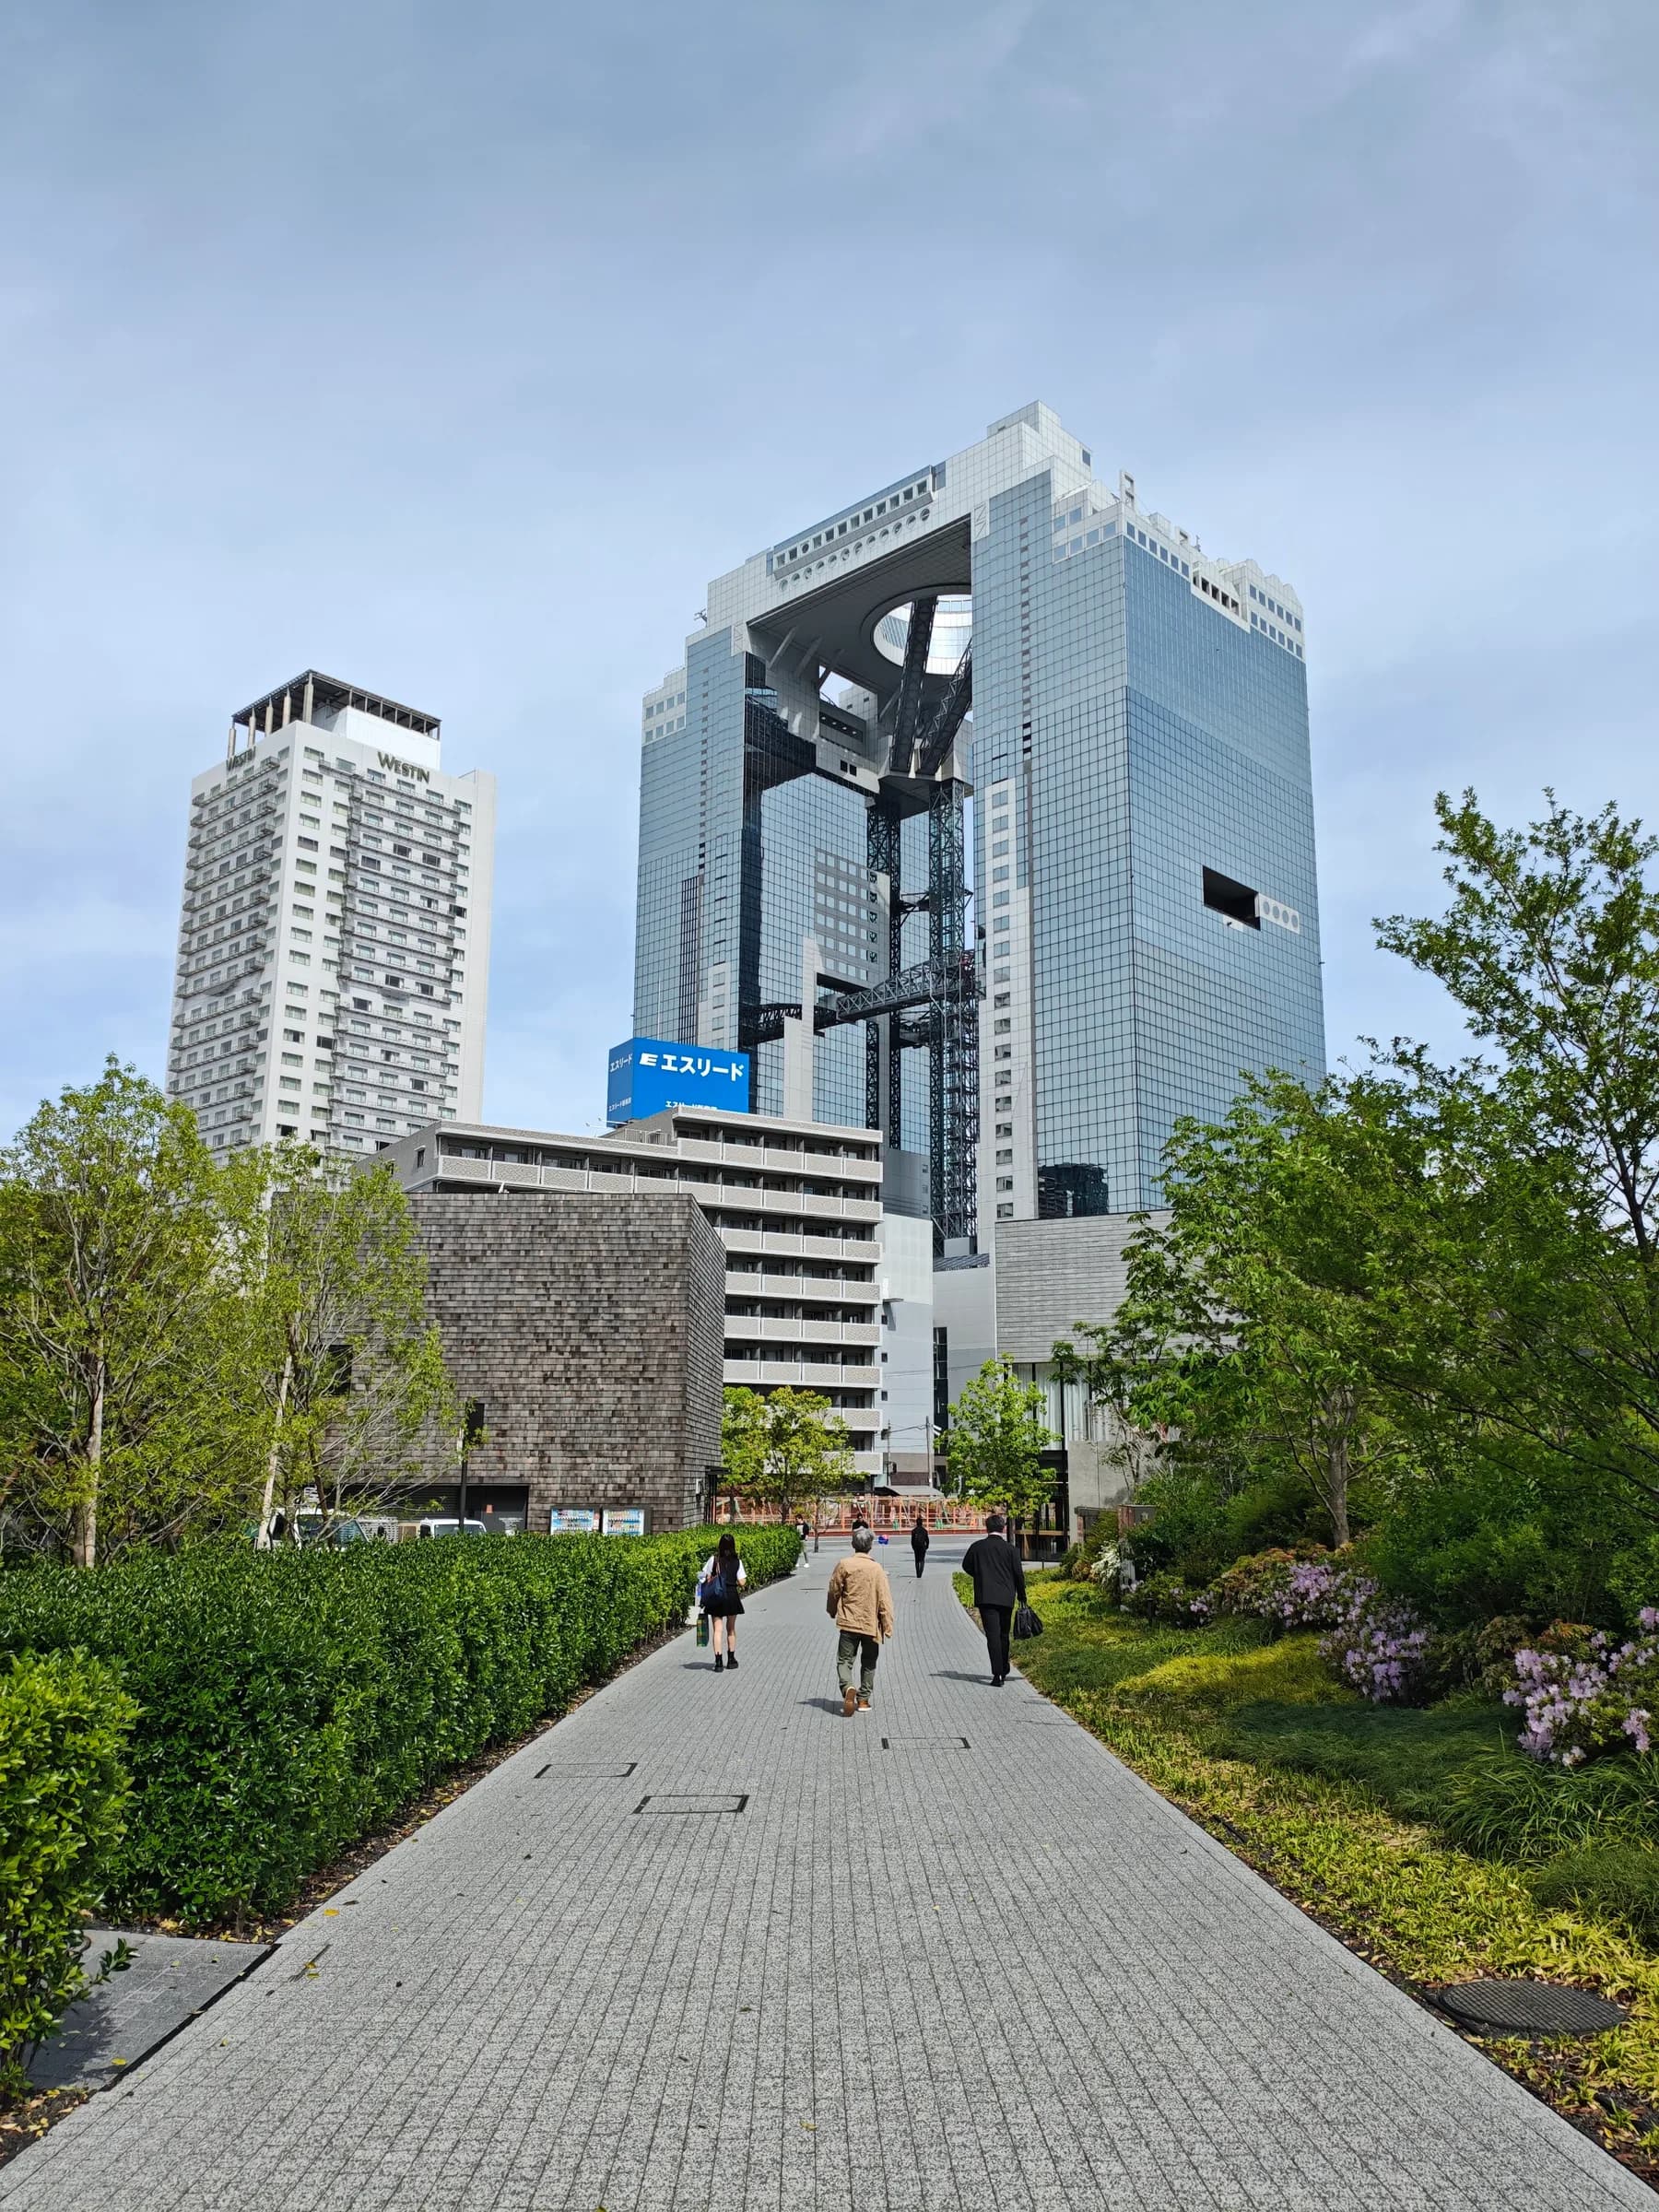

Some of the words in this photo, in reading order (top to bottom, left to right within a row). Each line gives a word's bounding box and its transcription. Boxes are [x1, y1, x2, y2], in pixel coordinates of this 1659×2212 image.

[226, 746, 256, 771] WESTIN
[377, 750, 430, 784] WESTIN
[609, 1053, 633, 1073] エスリード
[661, 1053, 745, 1082] エスリード
